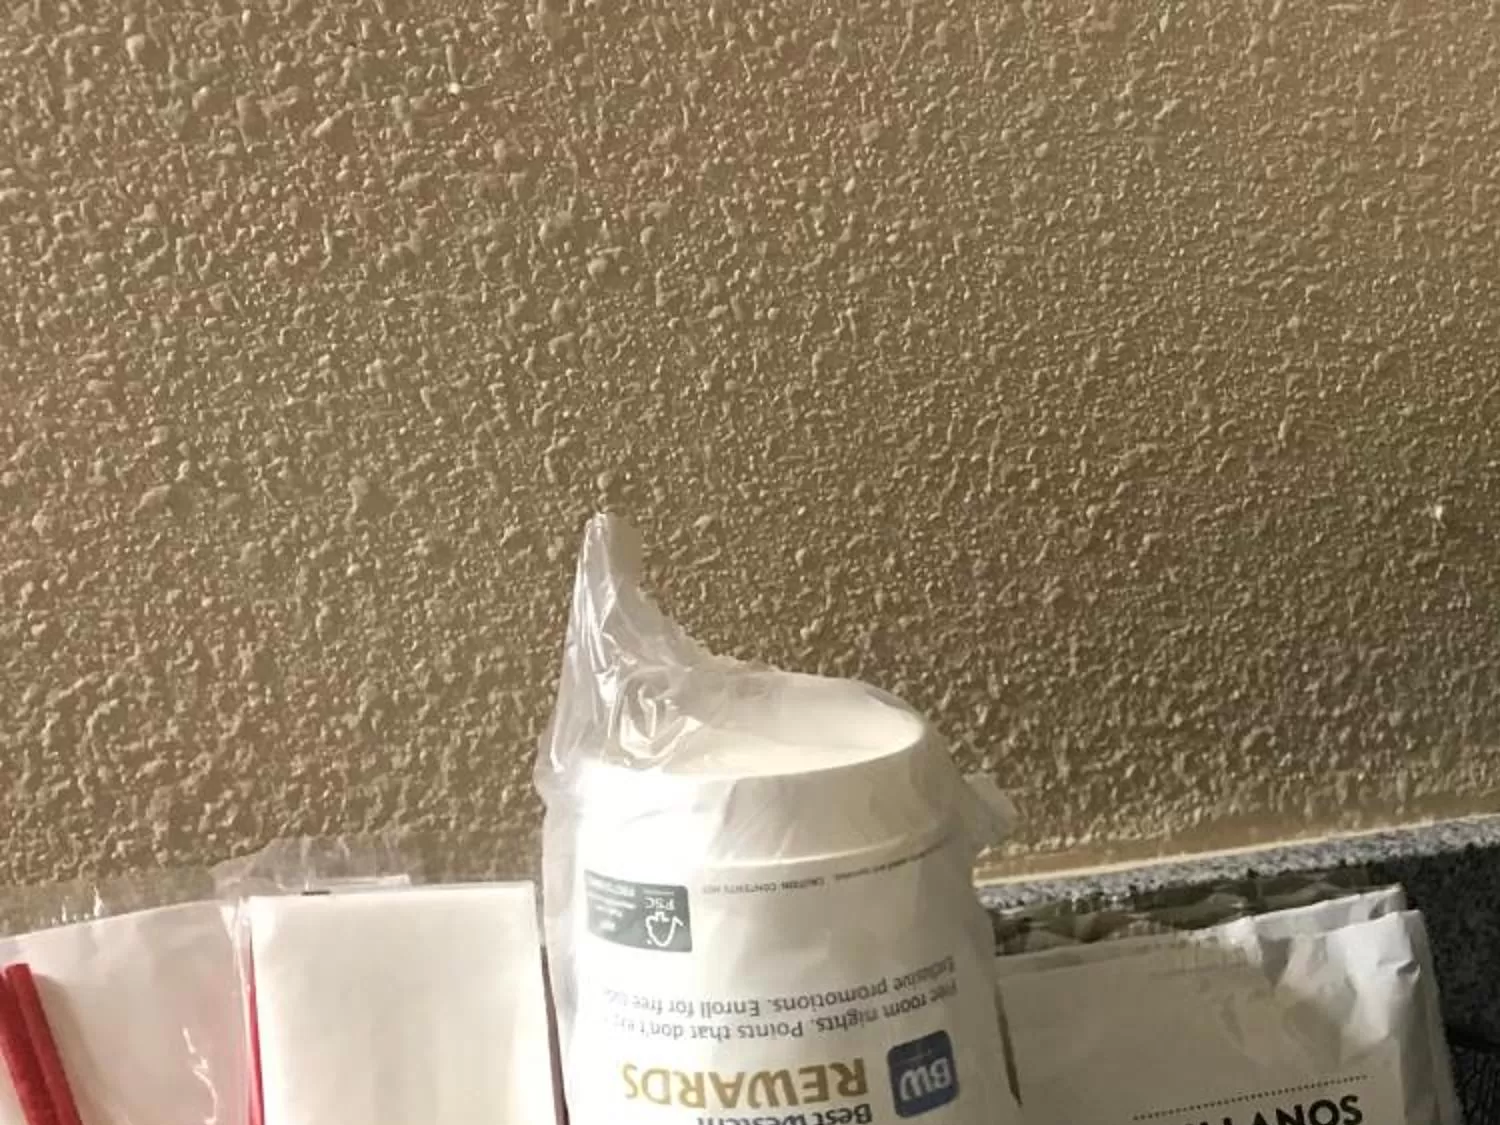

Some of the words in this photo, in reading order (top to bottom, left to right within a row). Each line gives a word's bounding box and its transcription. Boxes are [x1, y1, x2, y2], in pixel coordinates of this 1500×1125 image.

[668, 998, 694, 1017] for
[767, 976, 888, 1012] promotions.
[882, 992, 928, 1019] room
[700, 998, 760, 1020] Enroll
[809, 1007, 879, 1034] nights.
[690, 1022, 733, 1043] that
[736, 1020, 804, 1042] Points
[619, 1057, 869, 1110] REWARDS
[898, 1056, 953, 1102] BW
